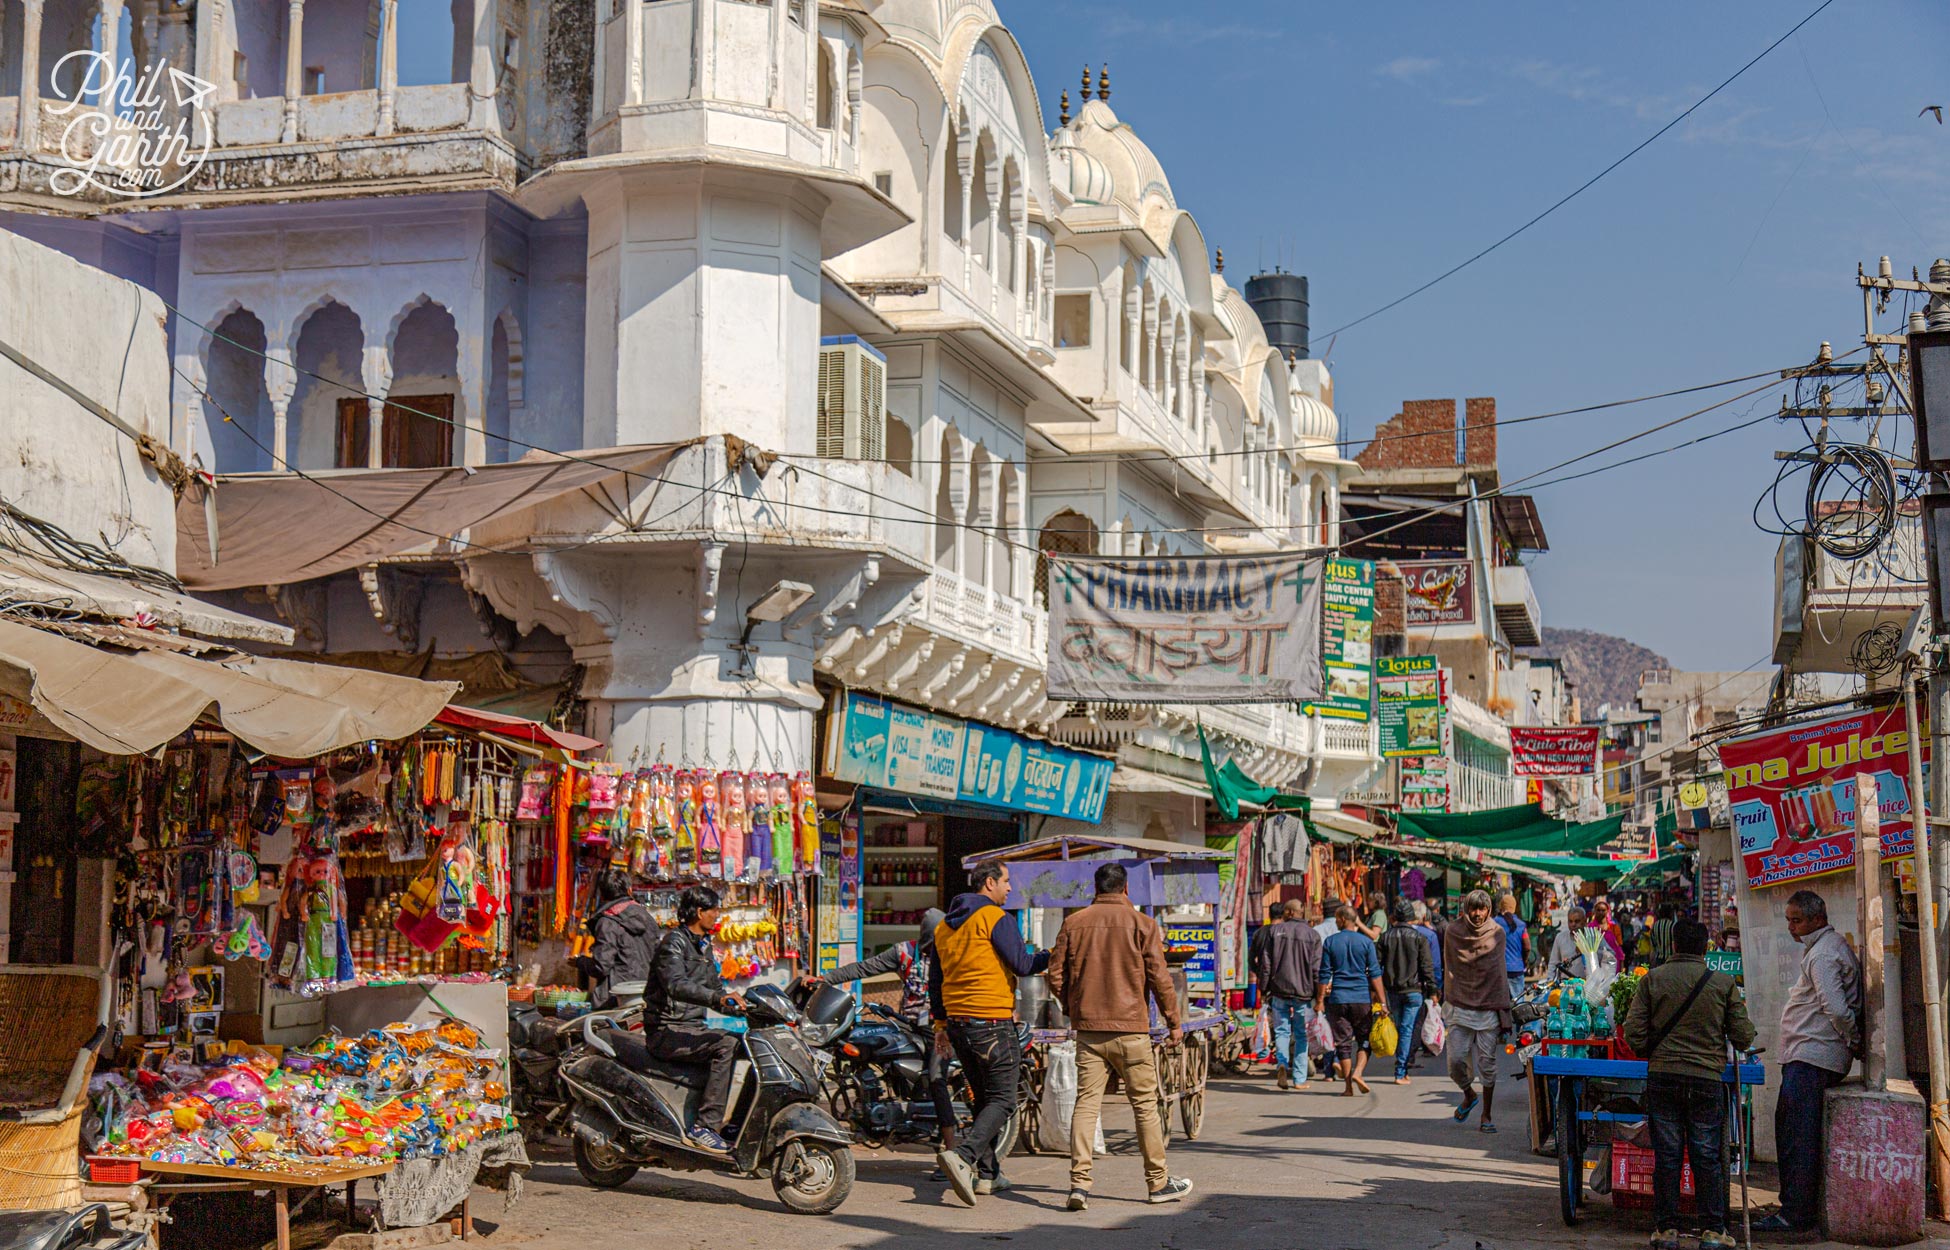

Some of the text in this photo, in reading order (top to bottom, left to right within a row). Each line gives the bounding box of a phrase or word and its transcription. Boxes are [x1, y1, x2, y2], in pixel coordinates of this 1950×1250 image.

[1085, 558, 1284, 612] PHARMACY
[1344, 585, 1373, 596] CENTER
[1349, 597, 1369, 607] CARE
[1379, 658, 1431, 676] Lotus
[931, 727, 955, 749] MONEY
[1789, 720, 1863, 743] Brahma Pushkar
[892, 735, 909, 755] VISA
[1524, 737, 1595, 752] Little Tibet
[1796, 730, 1909, 776] Juice
[925, 754, 955, 778] TRANSFER
[1547, 753, 1593, 763] RESTAURANT
[1024, 756, 1066, 791] नटराज
[1734, 809, 1767, 827] Fruit
[1833, 799, 1904, 826] Fru uice
[1741, 836, 1756, 849] ke
[1760, 842, 1842, 872] Fresh
[841, 861, 858, 879] VISA
[1765, 866, 1808, 882] Kashew
[1810, 855, 1853, 873] Almond
[1167, 929, 1214, 942] नटराज
[1703, 955, 1742, 971] isleri
